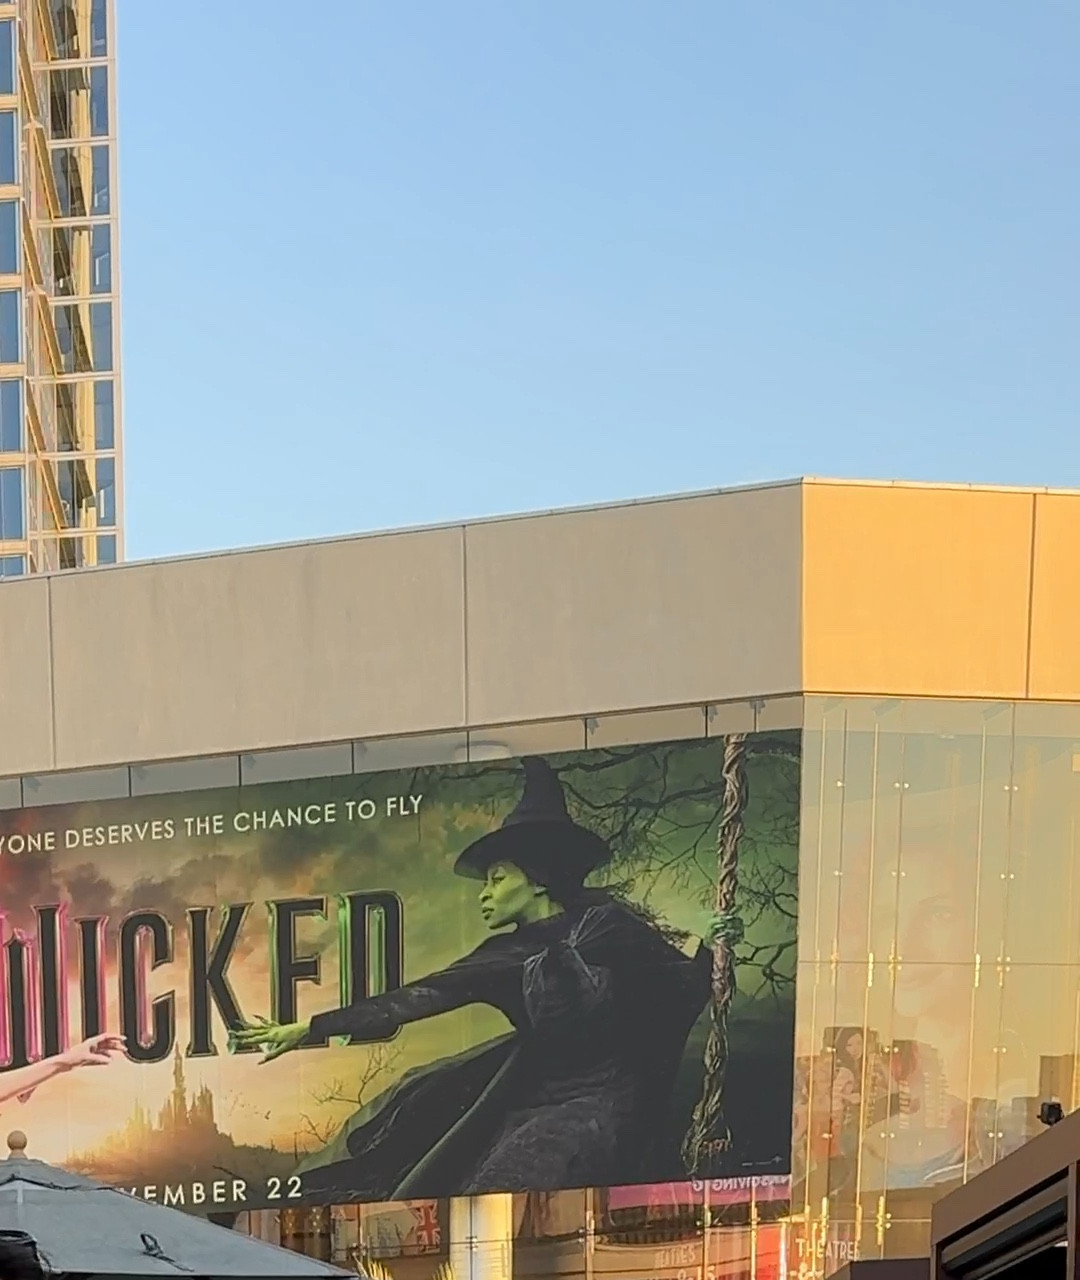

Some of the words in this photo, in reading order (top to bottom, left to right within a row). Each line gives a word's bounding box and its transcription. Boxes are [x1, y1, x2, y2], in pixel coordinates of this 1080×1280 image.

[65, 820, 174, 849] DESERVES
[184, 815, 224, 837] THE
[233, 804, 336, 832] CHANCE
[345, 800, 376, 821] TO
[387, 795, 422, 817] FLY
[267, 1176, 302, 1199] 22
